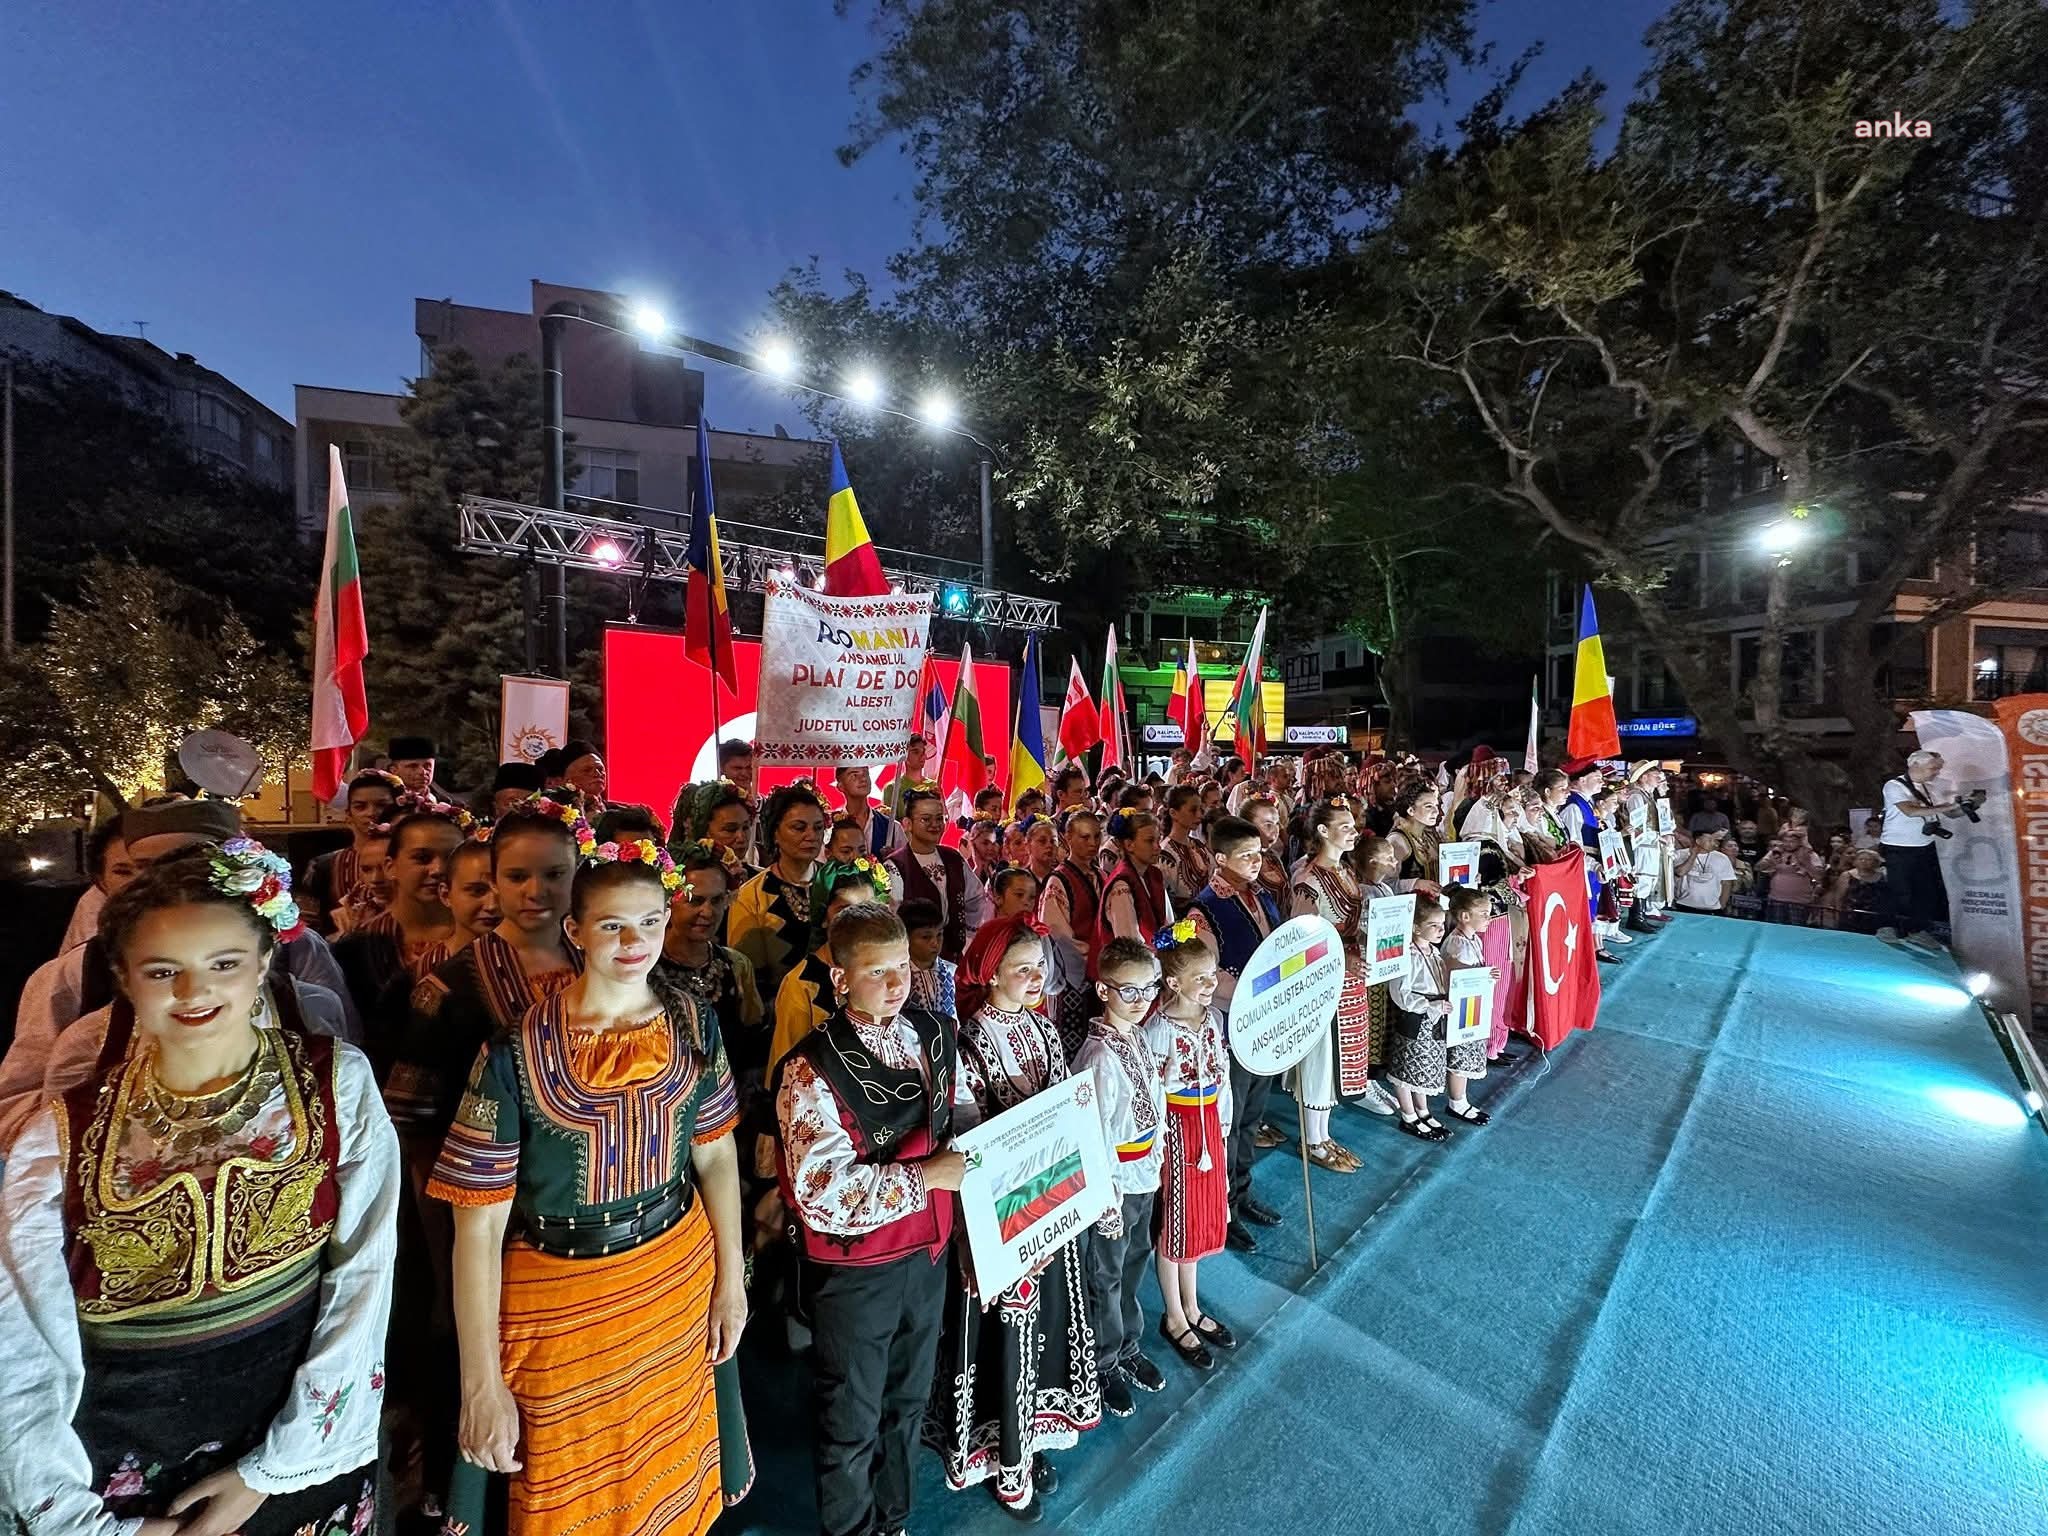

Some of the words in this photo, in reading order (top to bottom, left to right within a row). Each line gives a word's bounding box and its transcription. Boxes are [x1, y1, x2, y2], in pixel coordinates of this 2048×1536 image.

[816, 619, 922, 651] ROMÂNIA
[837, 652, 906, 666] ANSAMBLUL
[792, 663, 844, 688] PLAI
[856, 670, 886, 690] DE
[1236, 1001, 1273, 1033] COMUNA
[1251, 1013, 1298, 1057] ANSAMBLUL
[1298, 987, 1336, 1022] FOLCLORIC
[1018, 1207, 1081, 1264] BULGARIA
